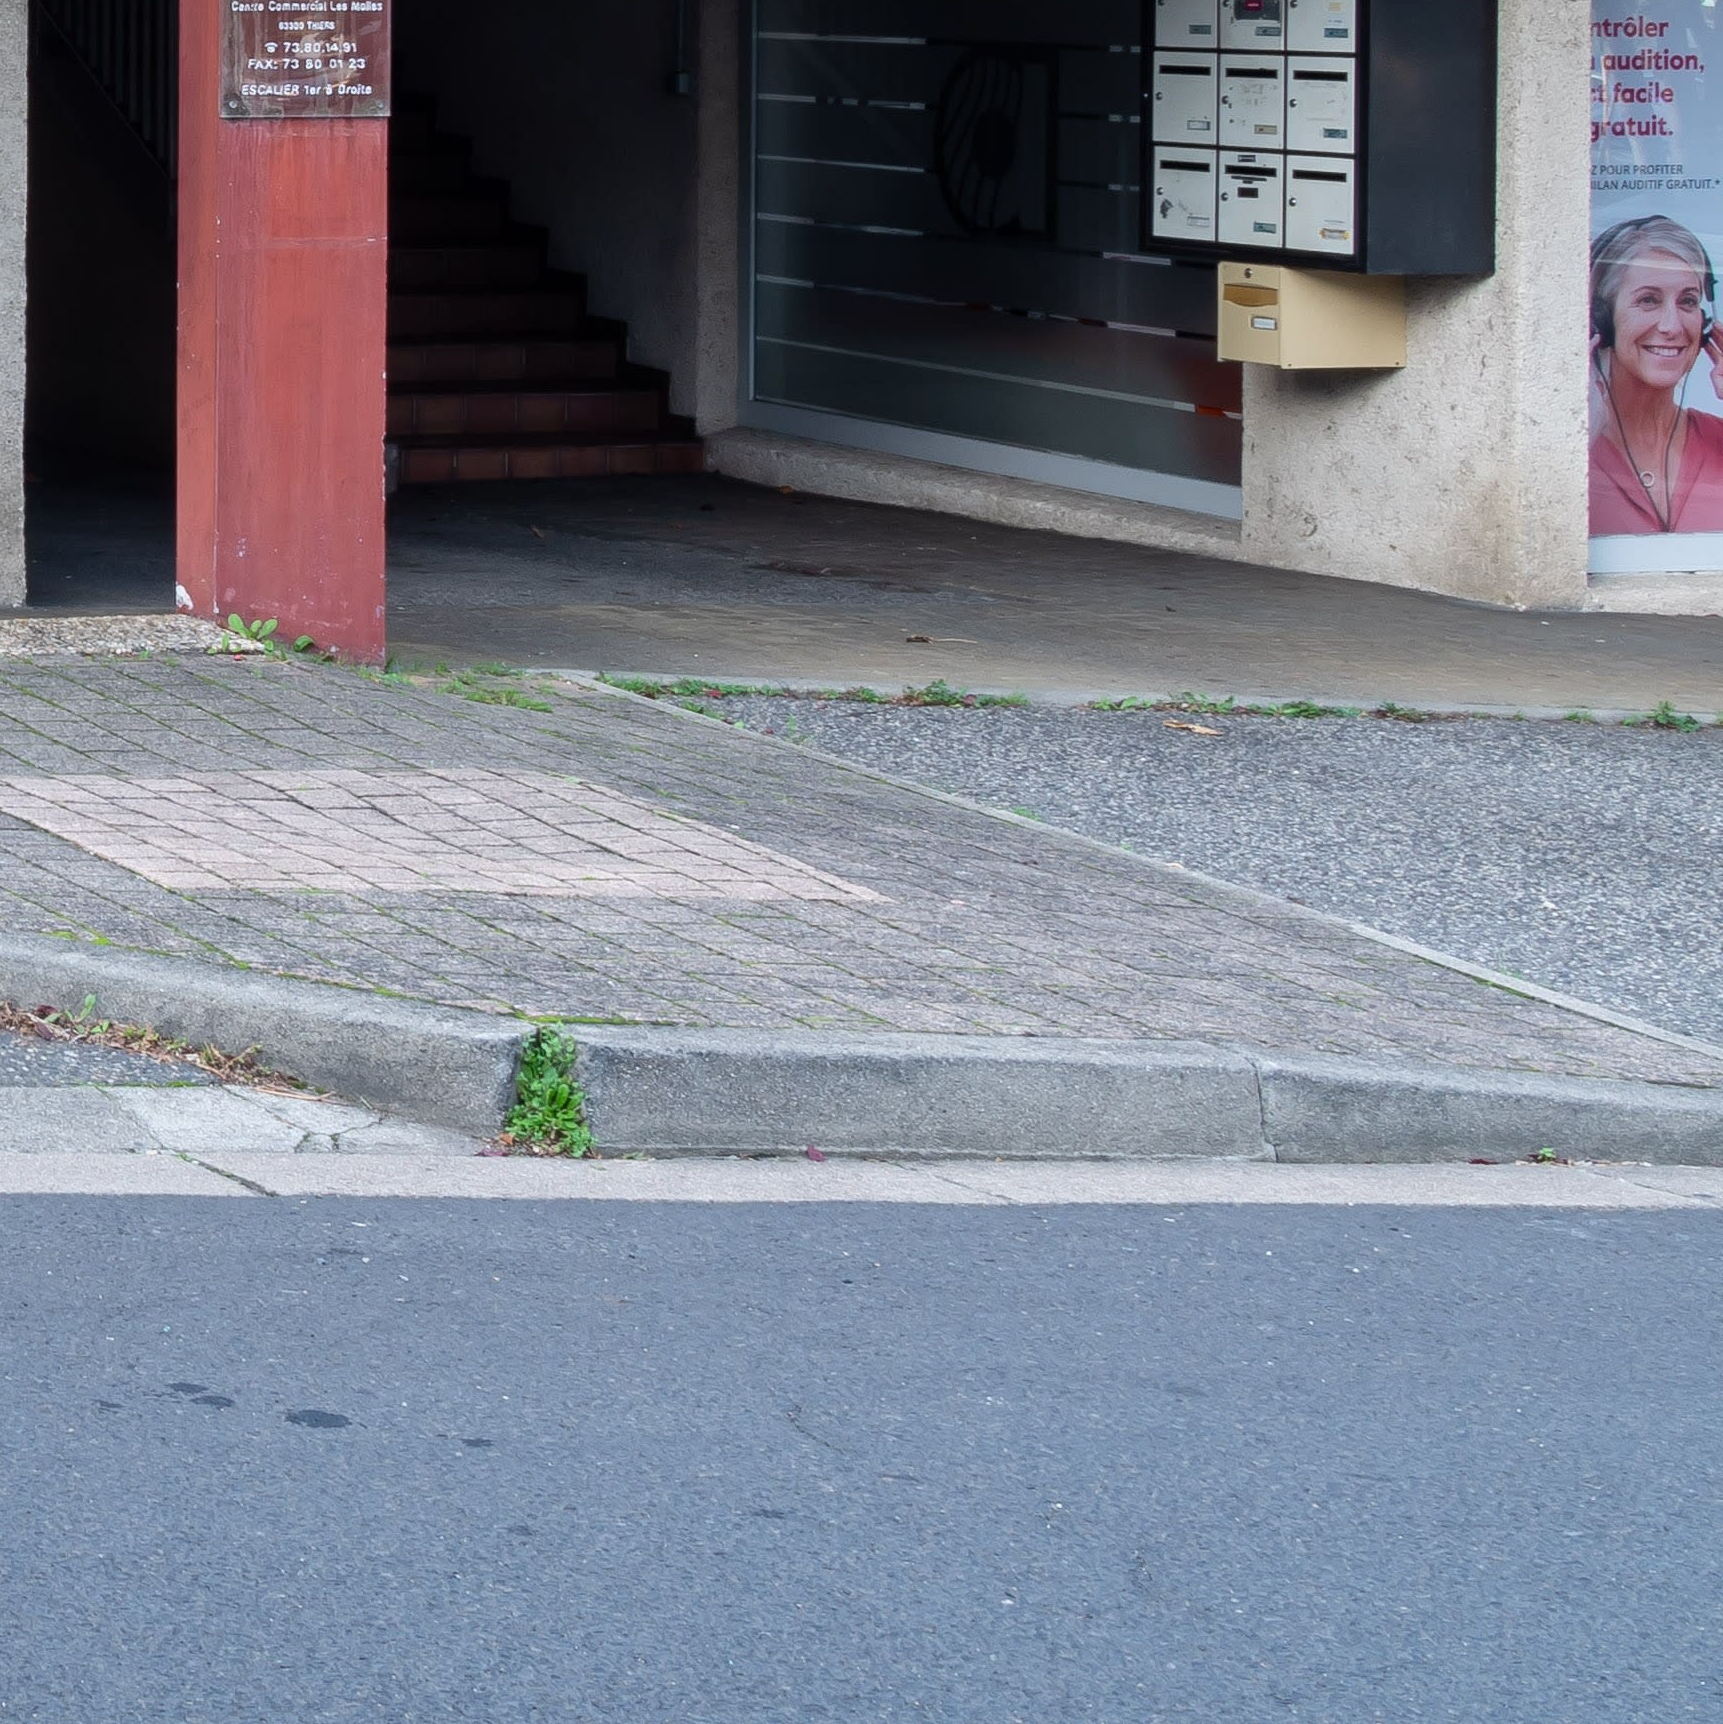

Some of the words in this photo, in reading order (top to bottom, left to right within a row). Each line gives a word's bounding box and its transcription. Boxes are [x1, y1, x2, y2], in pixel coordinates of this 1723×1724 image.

[231, 1, 264, 11] Centre
[268, 0, 326, 12] Commercial
[330, 1, 347, 11] Les
[1591, 16, 1669, 38] ntrôler
[283, 42, 357, 53] 73.80.14.91
[248, 59, 277, 69] FAX:
[283, 58, 299, 69] 73
[306, 58, 322, 69] 80
[329, 59, 343, 69] 01
[349, 58, 366, 69] 23
[1603, 48, 1704, 74] audition,
[242, 84, 299, 96] ESCALIER
[304, 85, 321, 95] 1er
[338, 84, 372, 95] Droite
[1614, 82, 1674, 103] facile
[1600, 165, 1630, 175] POUR
[1634, 165, 1683, 175] PROFITER
[1621, 179, 1663, 190] AUDITIF
